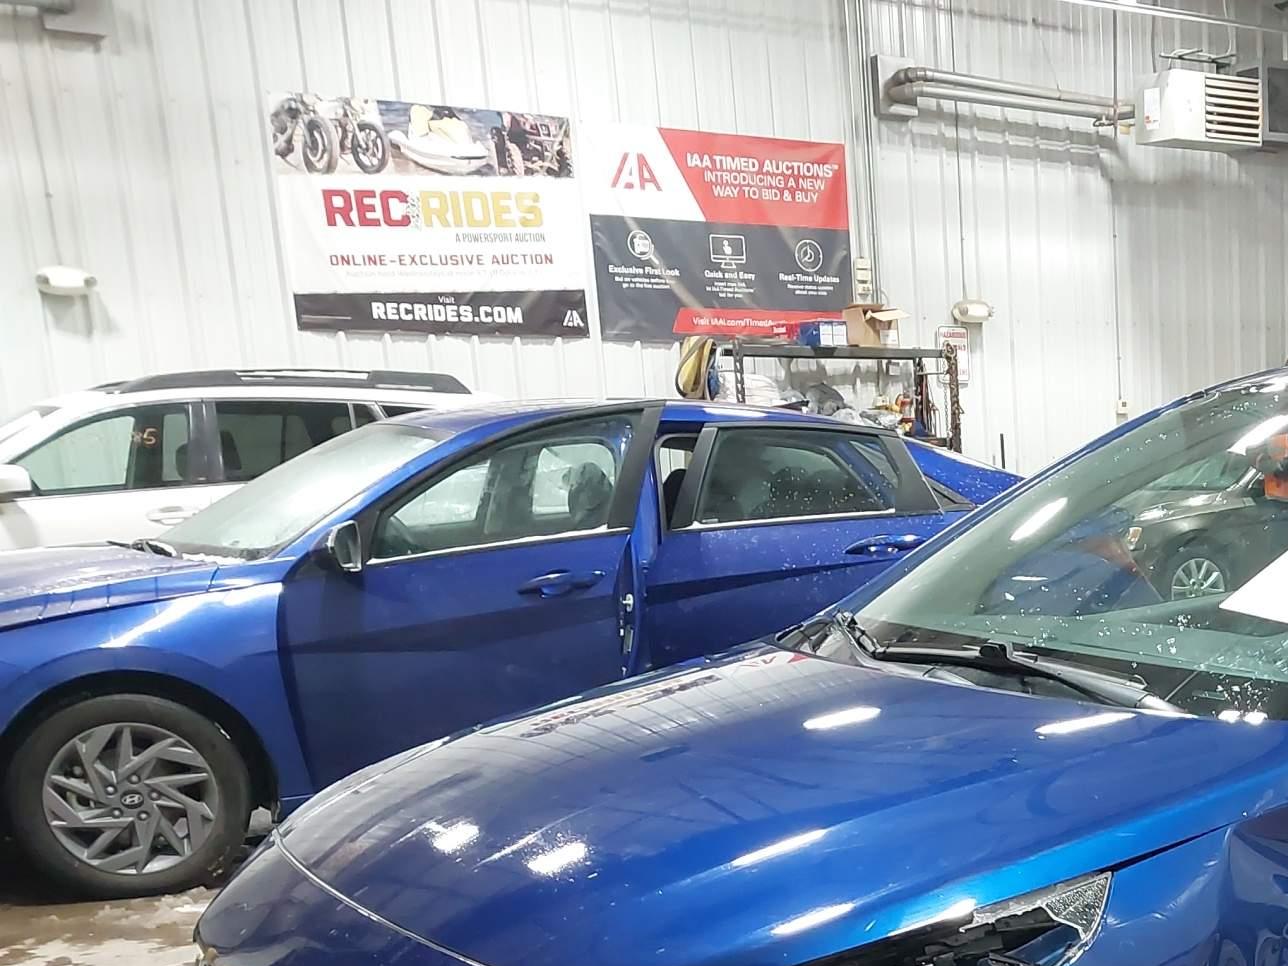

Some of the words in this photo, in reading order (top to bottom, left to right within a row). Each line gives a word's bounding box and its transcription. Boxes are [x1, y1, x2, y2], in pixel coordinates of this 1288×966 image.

[686, 152, 712, 169] IAA
[713, 155, 759, 172] TIMED
[704, 170, 784, 188] INTRODUCING
[787, 177, 796, 188] A
[799, 178, 825, 190] NEW
[712, 185, 740, 198] WAY
[743, 187, 759, 199] TO
[762, 188, 780, 200] BID
[783, 190, 792, 201] &
[795, 191, 818, 203] BUY
[322, 189, 411, 227] REC
[419, 190, 544, 228] RIDES
[455, 232, 461, 243] A
[463, 232, 513, 244] POWERSPORT
[514, 232, 546, 243] AUCTION
[329, 253, 485, 266] ONLINE-EXCLUSIVE
[491, 253, 554, 265] AUCTION
[608, 264, 644, 274] Exclusive
[704, 270, 723, 279] Quick
[725, 271, 737, 280] and
[740, 272, 755, 281] Easy
[779, 273, 812, 282] Real-Time
[814, 275, 840, 283] Updates
[438, 295, 455, 303] Visit
[371, 302, 523, 324] RECRIDES.COM
[692, 317, 710, 326] Visit
